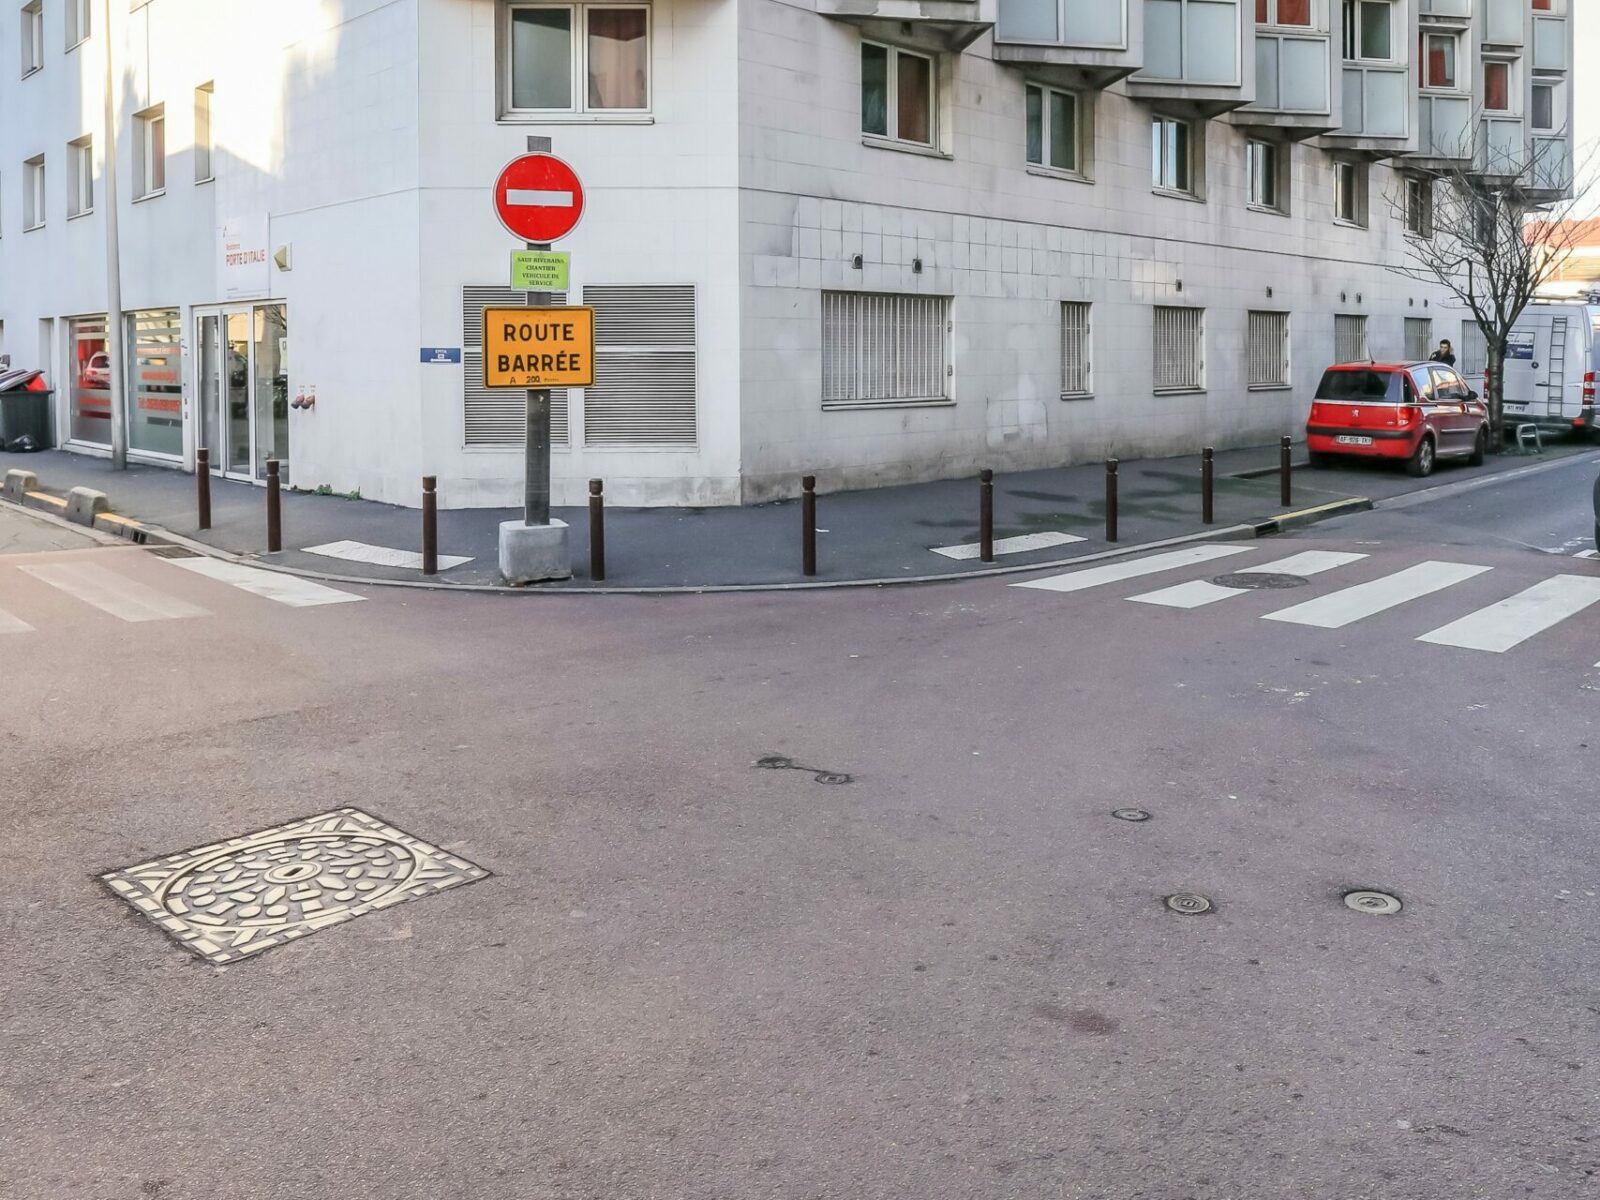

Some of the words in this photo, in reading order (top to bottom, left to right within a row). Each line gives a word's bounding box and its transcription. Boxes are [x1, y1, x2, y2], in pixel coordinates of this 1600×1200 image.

[226, 252, 242, 266] PORTE
[244, 249, 265, 264] D'ITALIE
[503, 323, 575, 341] ROUTE
[498, 350, 581, 372] BARRÉE
[510, 376, 517, 384] A
[526, 375, 541, 384] 200
